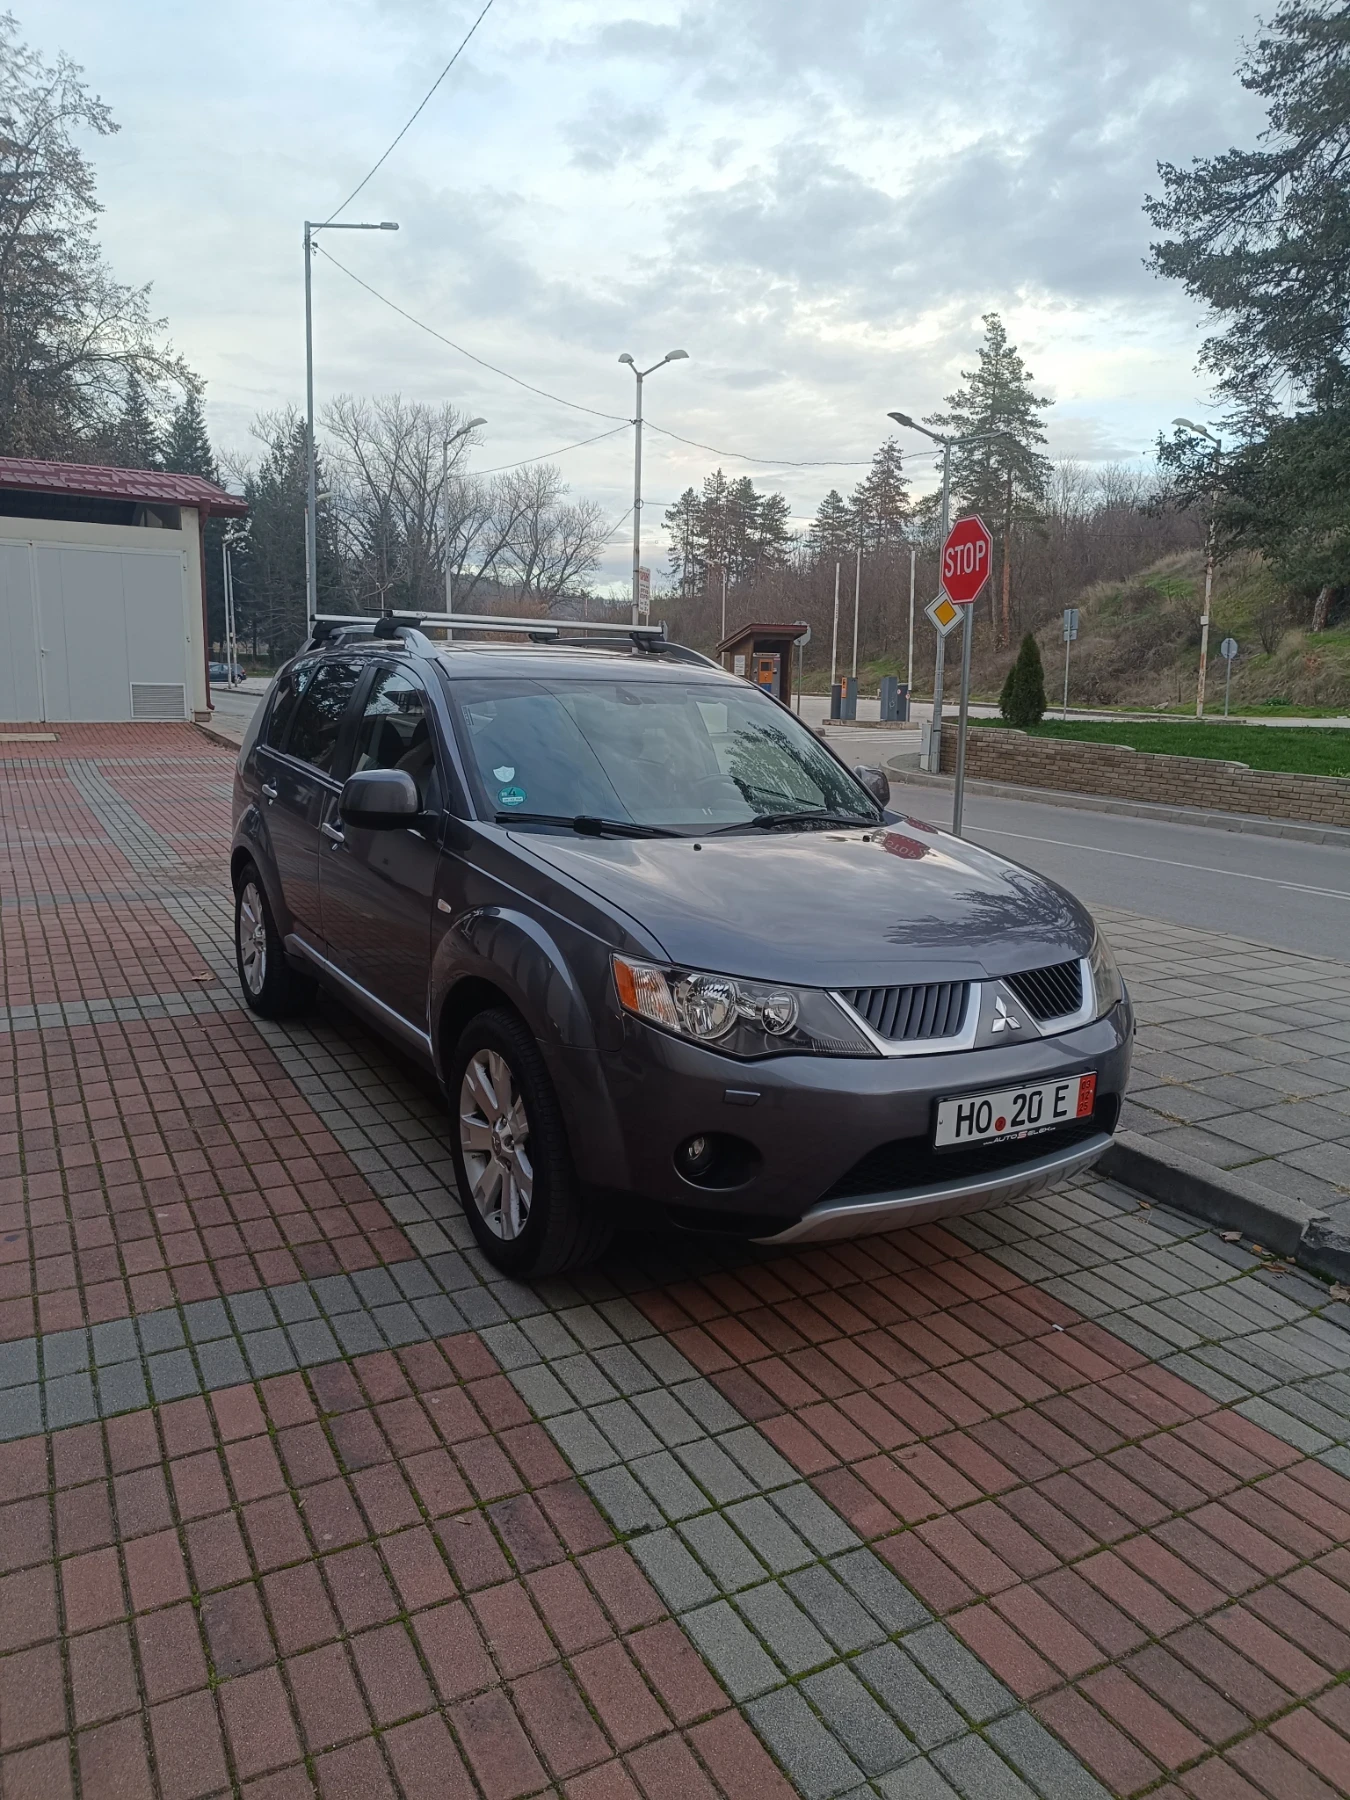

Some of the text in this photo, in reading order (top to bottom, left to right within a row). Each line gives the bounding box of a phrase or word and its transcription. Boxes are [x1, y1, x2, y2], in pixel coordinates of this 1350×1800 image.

[945, 540, 986, 578] STOP
[508, 788, 516, 797] 4
[955, 1084, 1069, 1137] HO 20 E
